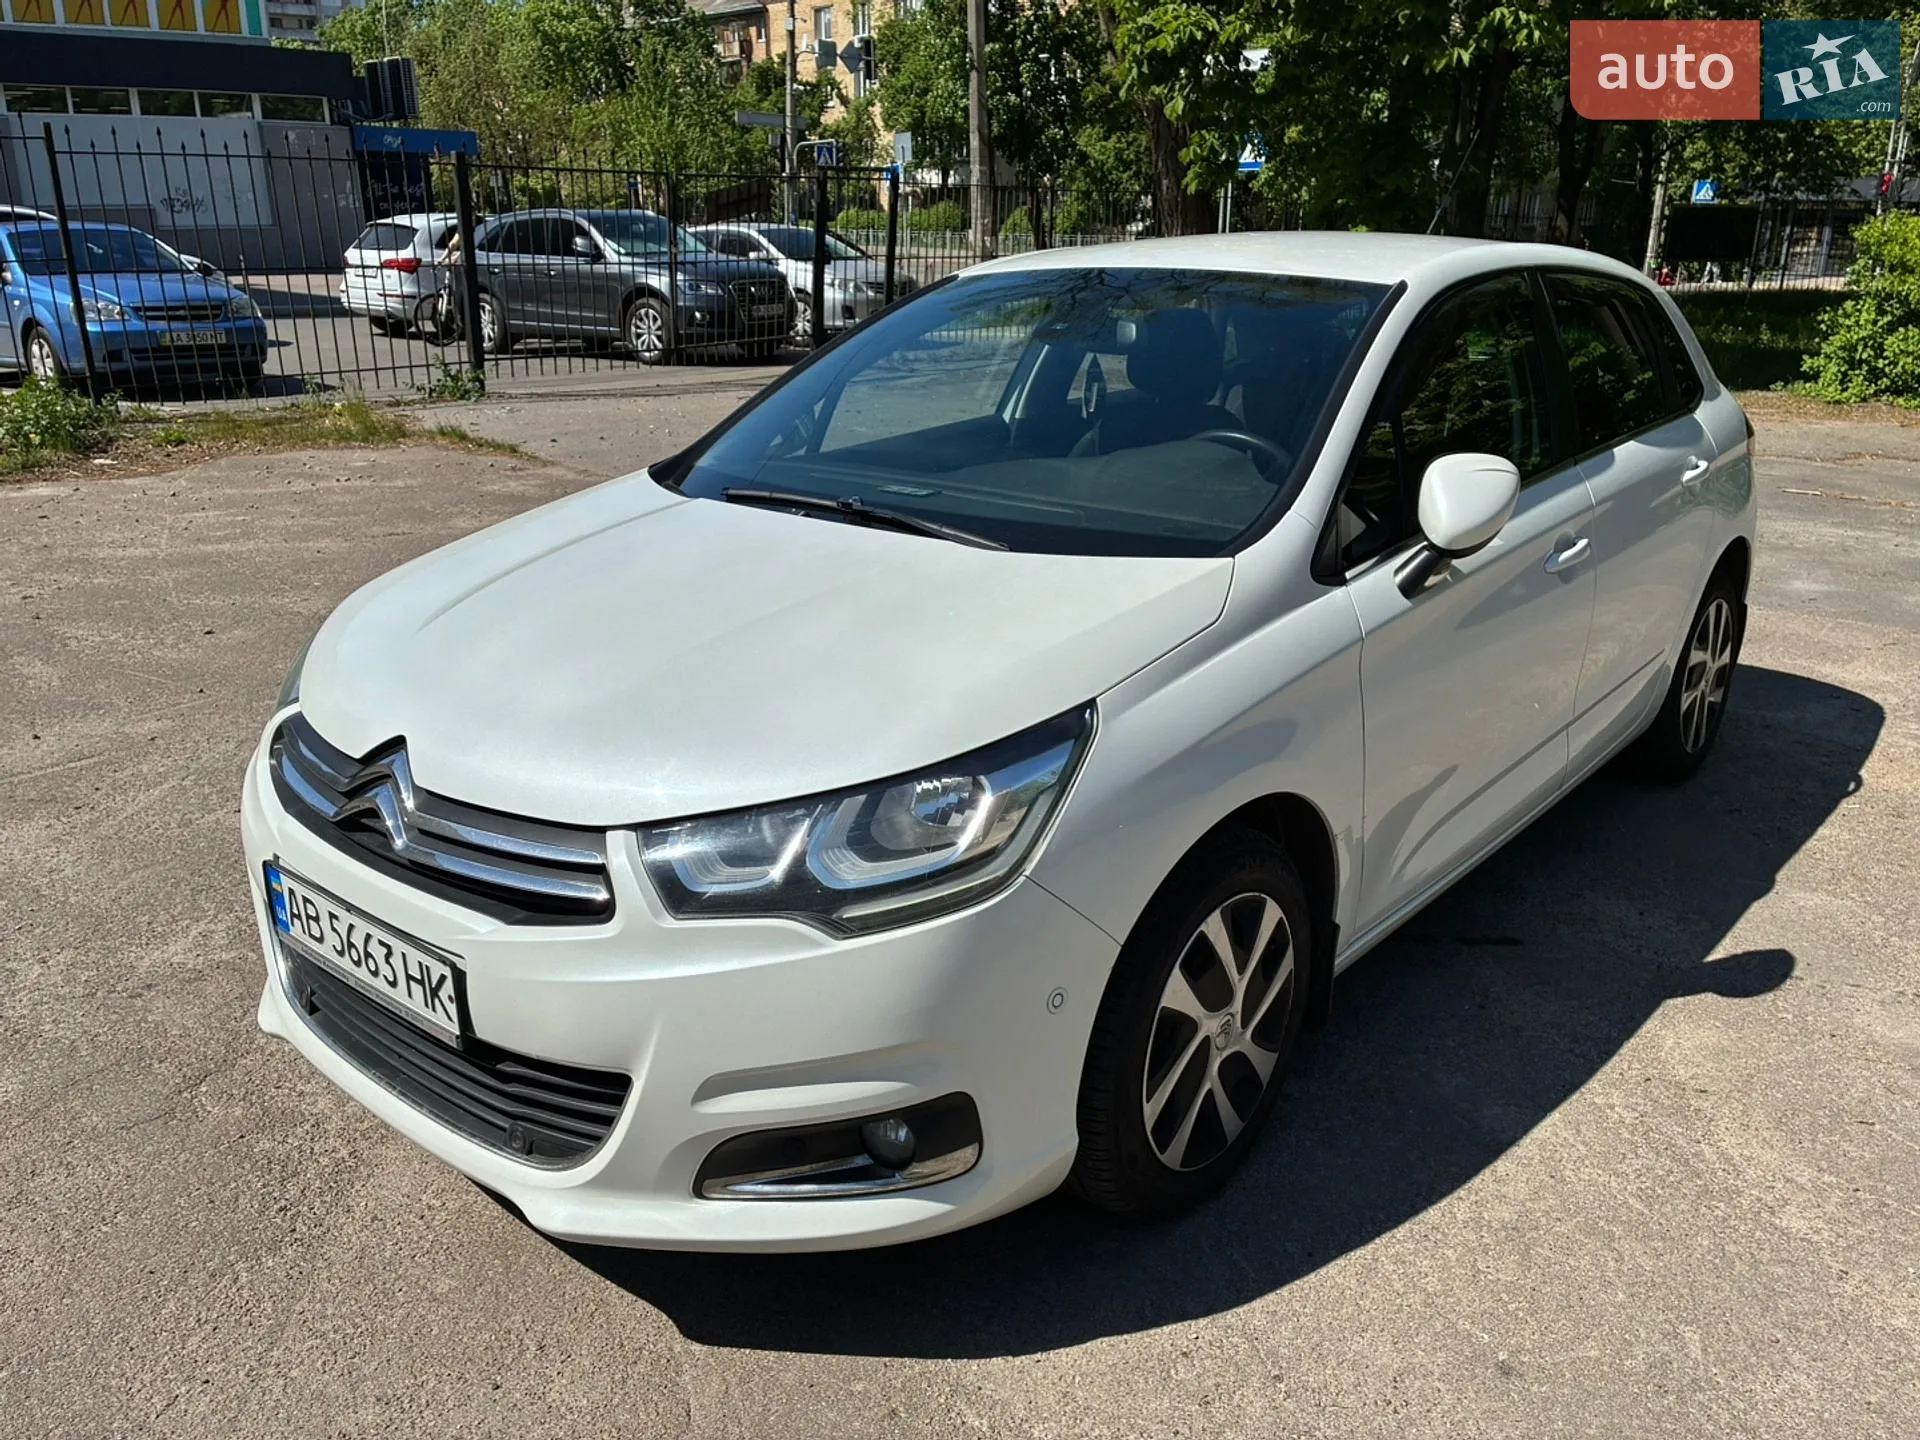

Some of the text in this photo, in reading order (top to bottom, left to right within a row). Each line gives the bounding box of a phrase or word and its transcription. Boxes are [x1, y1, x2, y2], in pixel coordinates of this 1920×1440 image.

[287, 886, 325, 945] AB
[328, 909, 399, 989] 5663
[401, 950, 456, 1024] HK
